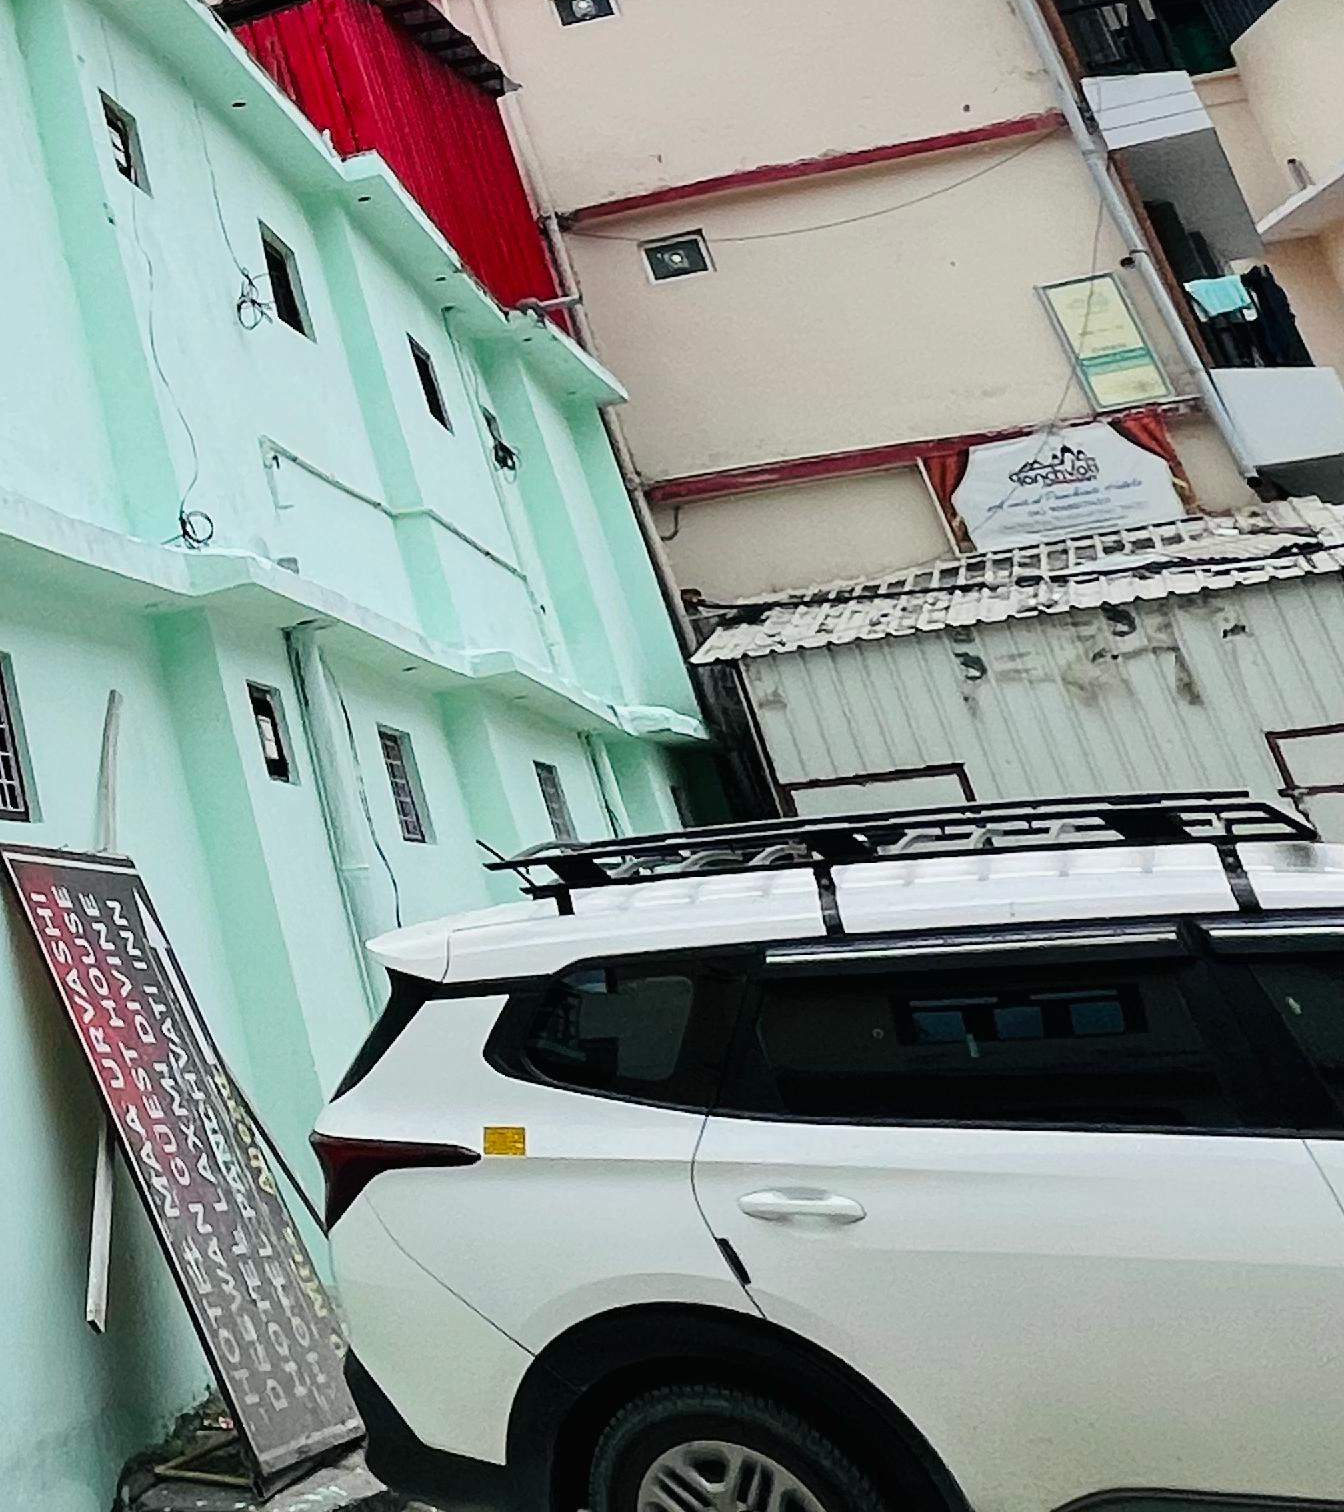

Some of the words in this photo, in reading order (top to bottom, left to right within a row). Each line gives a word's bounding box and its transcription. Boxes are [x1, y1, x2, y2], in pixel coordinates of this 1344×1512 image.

[30, 891, 126, 1090] URVASHI
[51, 885, 126, 1029] HOUSE
[78, 891, 157, 1045] DIVINE
[105, 899, 148, 971] INN
[118, 1040, 192, 1187] GUEST
[124, 1103, 180, 1218] MAA
[143, 986, 257, 1219] PANCHVATI
[160, 1061, 228, 1212] LAXMI
[182, 1237, 260, 1406] HOTEL
[188, 1202, 288, 1412] DEEWAN
[232, 1228, 308, 1397] HOTEL
[258, 1229, 328, 1385] HOTEL
